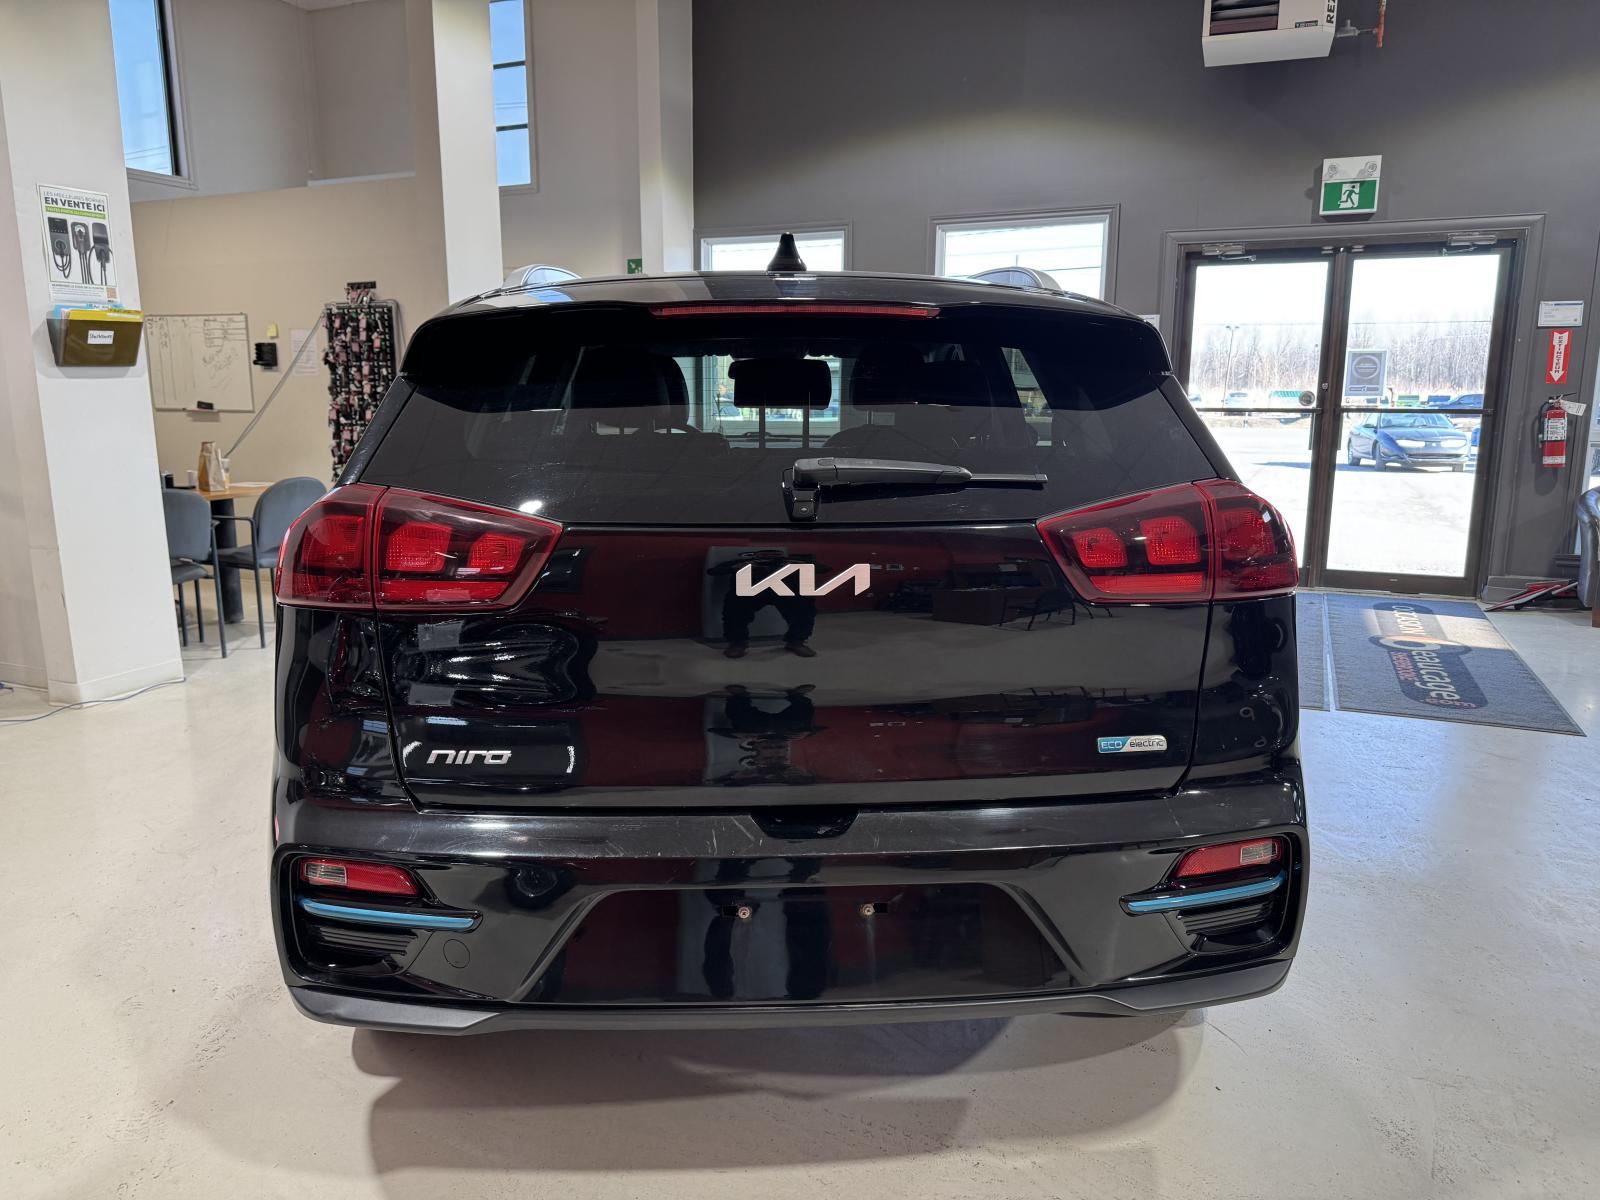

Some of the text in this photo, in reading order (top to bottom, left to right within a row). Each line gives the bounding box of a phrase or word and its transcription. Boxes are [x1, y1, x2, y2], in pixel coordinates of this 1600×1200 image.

[44, 197, 59, 206] EN
[60, 200, 92, 211] VENTE
[93, 204, 105, 213] ICI
[735, 563, 870, 596] KIA
[1391, 605, 1426, 635] OCCASION
[1101, 738, 1164, 749] ECO electric
[426, 749, 513, 765] niro
